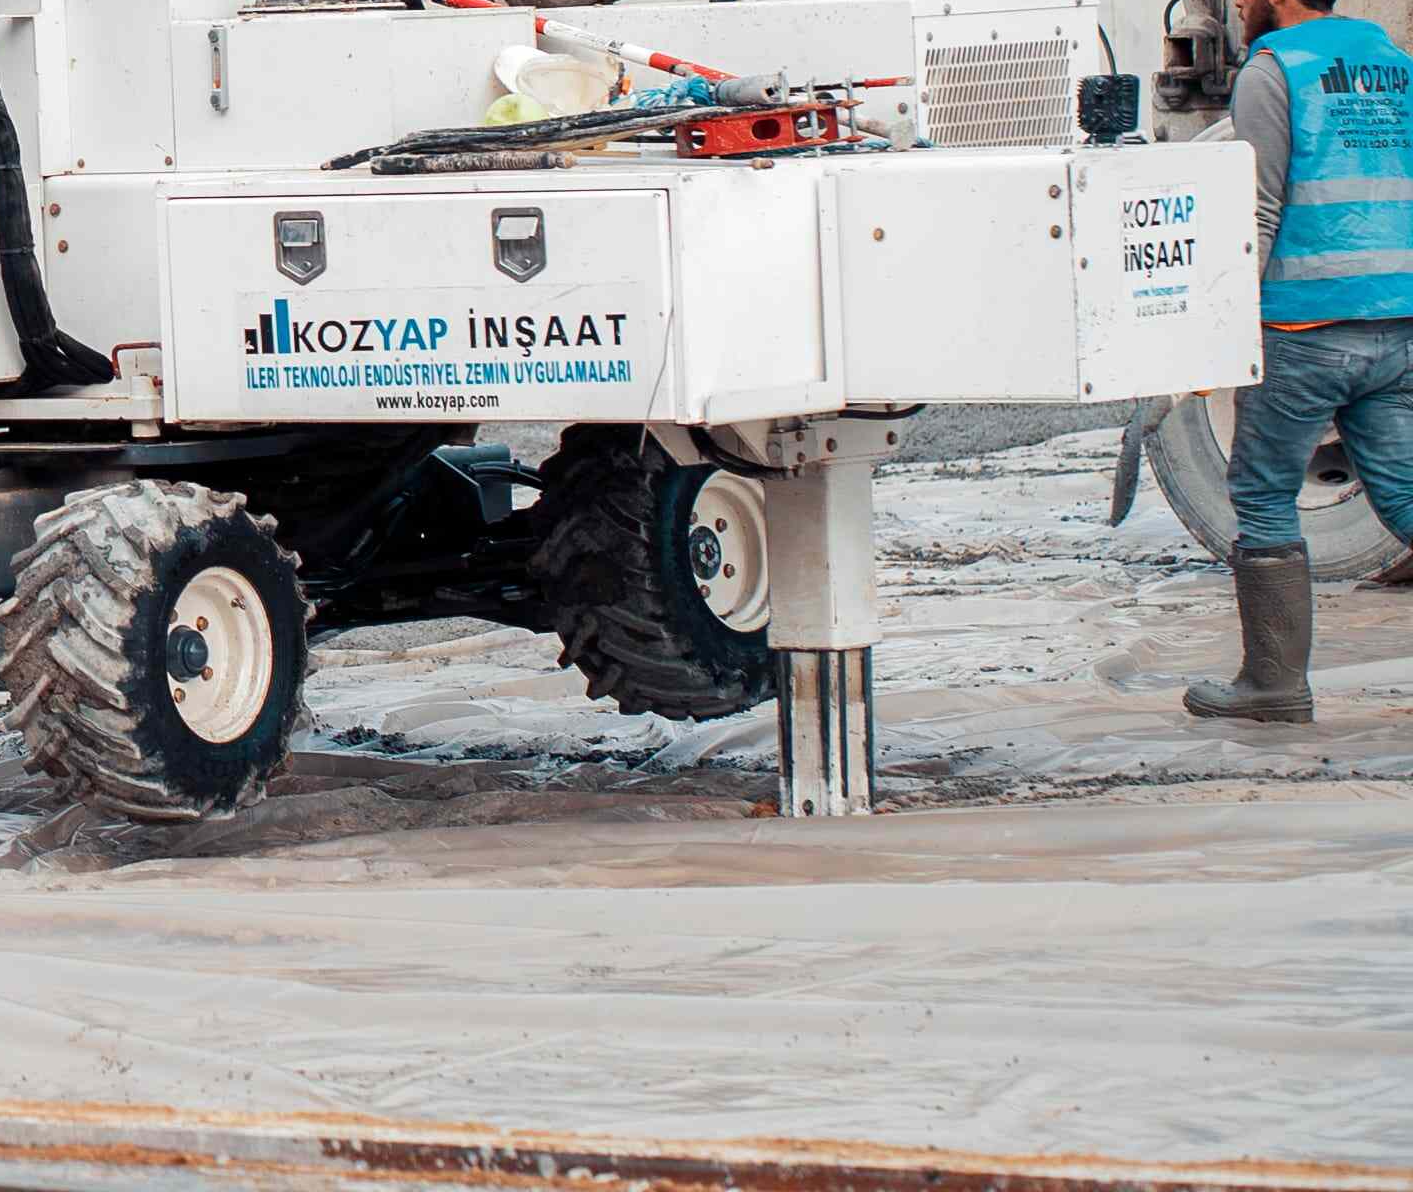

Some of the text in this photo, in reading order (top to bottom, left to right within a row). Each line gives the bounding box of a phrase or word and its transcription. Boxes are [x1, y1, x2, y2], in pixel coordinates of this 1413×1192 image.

[1123, 195, 1194, 228] KOZYAP
[1124, 237, 1195, 278] İNŞAAT
[293, 308, 628, 357] KOZYAP İNŞAAT
[246, 356, 632, 389] İLERİ TEKNOLOJİ ENDÜSTRİYEL ZEMİN UYGULAMALARI
[376, 391, 500, 412] www.kozyap.com
